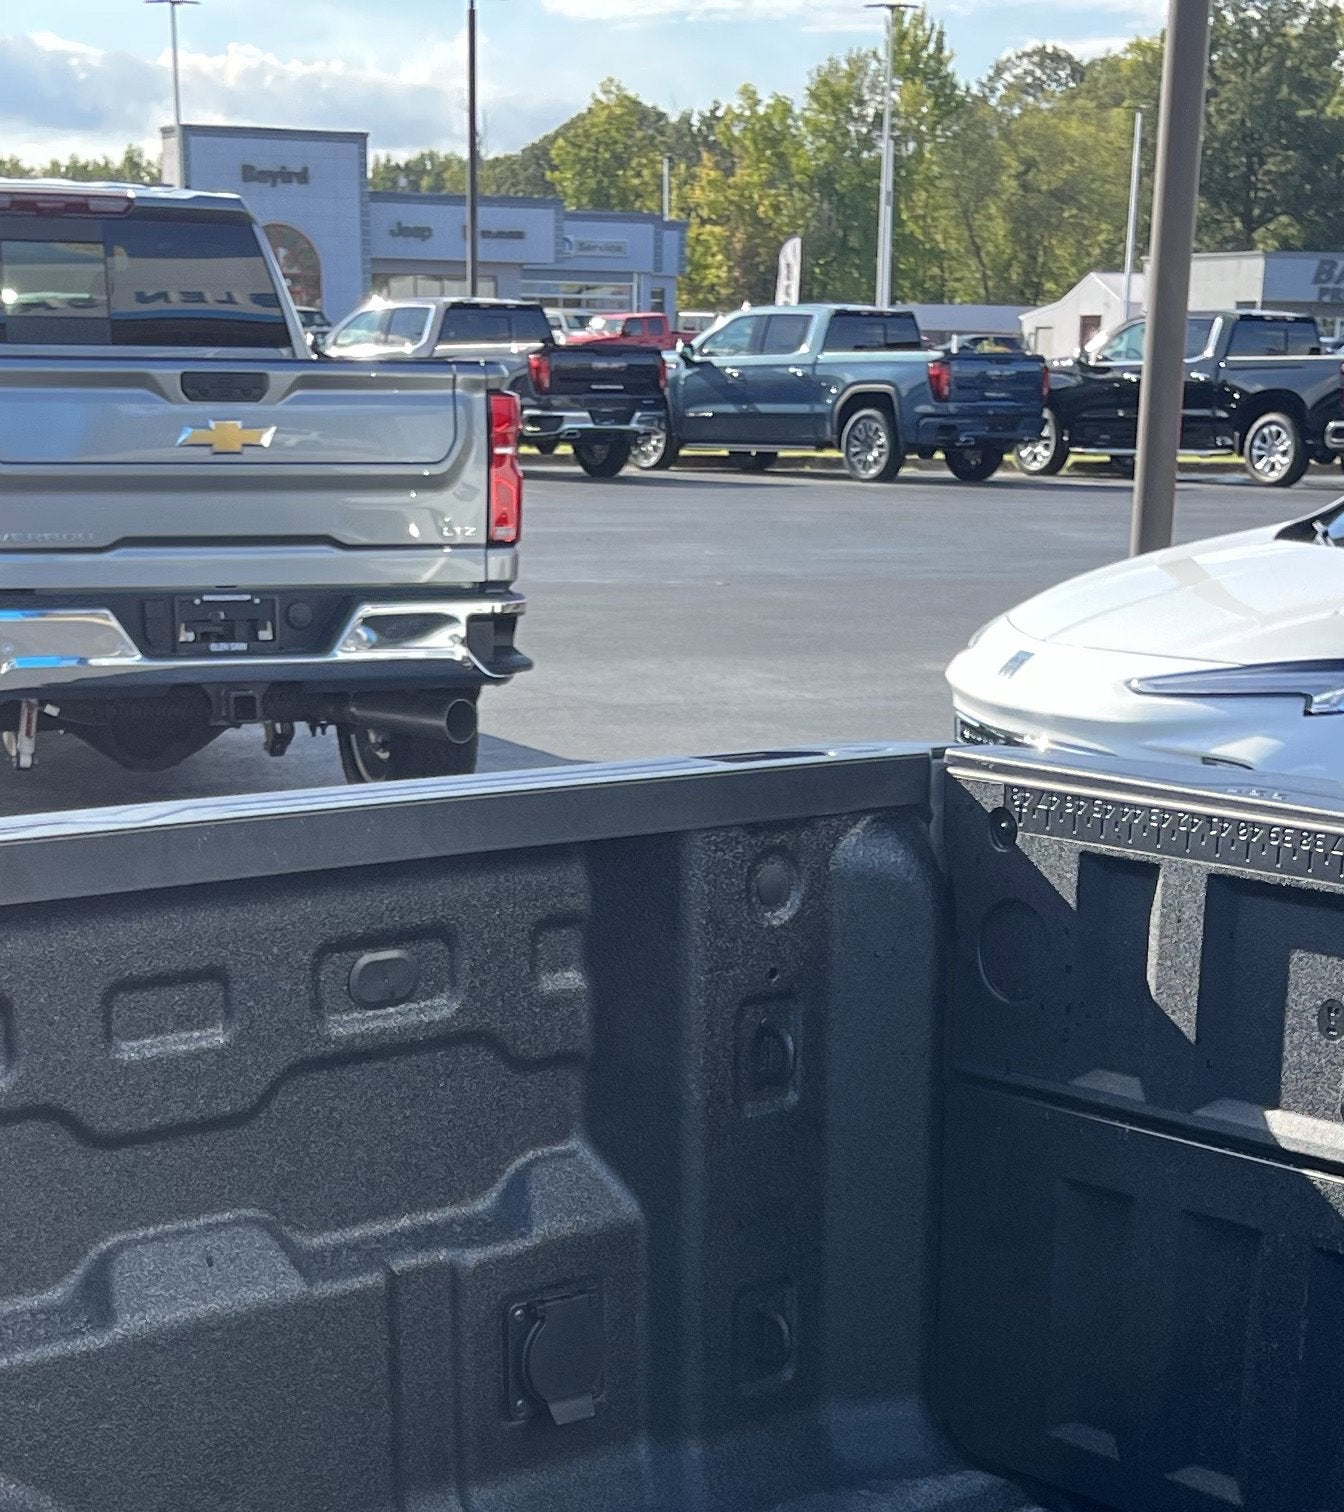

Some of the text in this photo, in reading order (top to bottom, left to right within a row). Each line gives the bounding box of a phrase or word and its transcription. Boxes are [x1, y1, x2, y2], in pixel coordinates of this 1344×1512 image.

[442, 526, 477, 537] LTZ
[1012, 787, 1033, 807] 48
[1037, 793, 1061, 810] 47
[1064, 796, 1088, 815] 46
[1093, 800, 1116, 819] 45
[1120, 806, 1145, 824] 44
[1150, 808, 1173, 828] 43
[1178, 812, 1203, 833] 42
[1209, 817, 1233, 838] 41
[1238, 822, 1263, 843] 40
[1269, 826, 1295, 848] 39
[1300, 831, 1326, 853] 38
